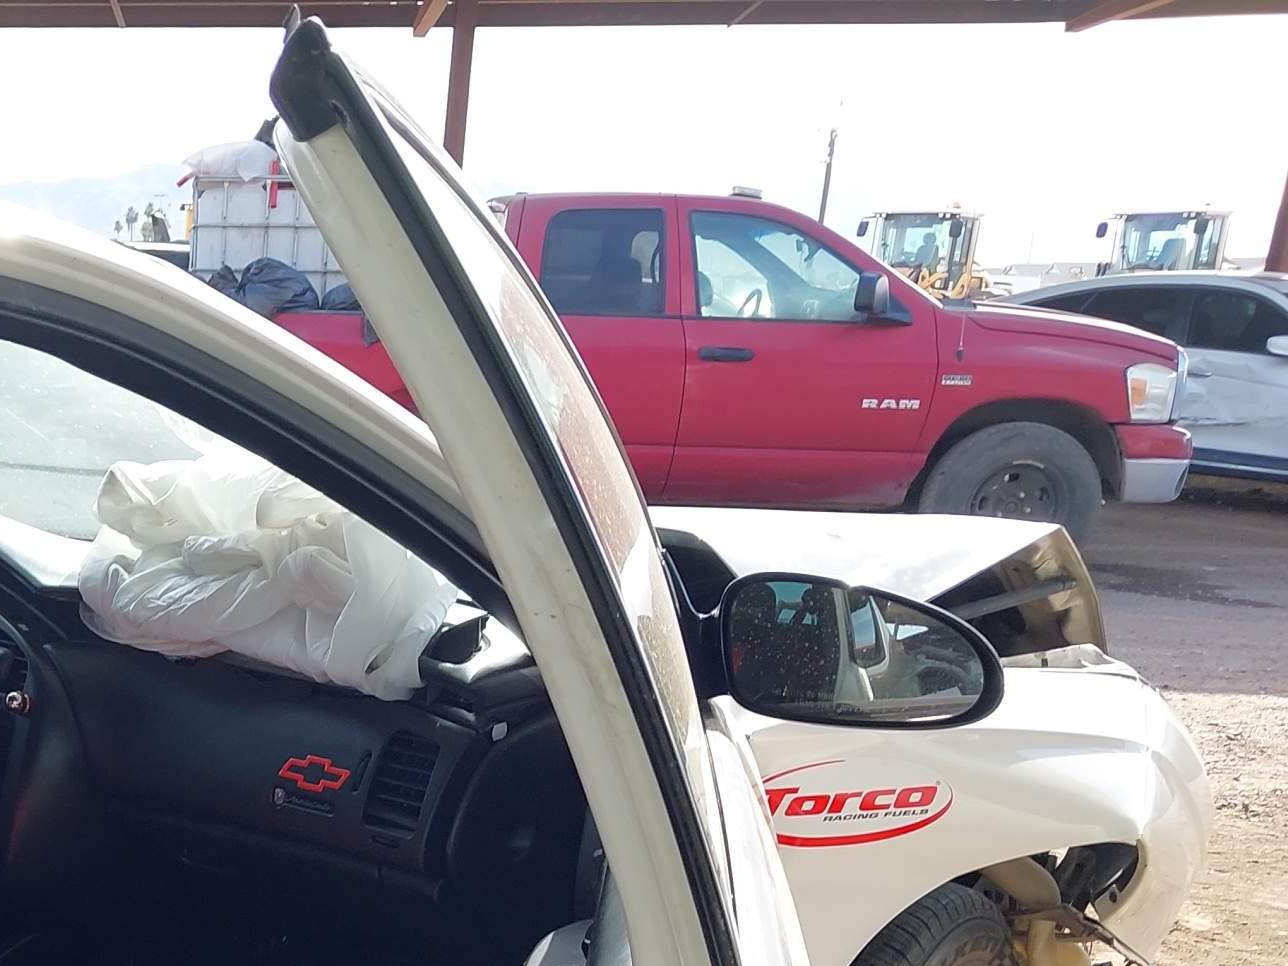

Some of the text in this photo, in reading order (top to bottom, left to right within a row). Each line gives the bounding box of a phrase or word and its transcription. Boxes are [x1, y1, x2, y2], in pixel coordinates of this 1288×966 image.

[861, 398, 921, 409] RAM
[765, 785, 938, 817] Torco
[822, 808, 930, 822] RACING FUELS
